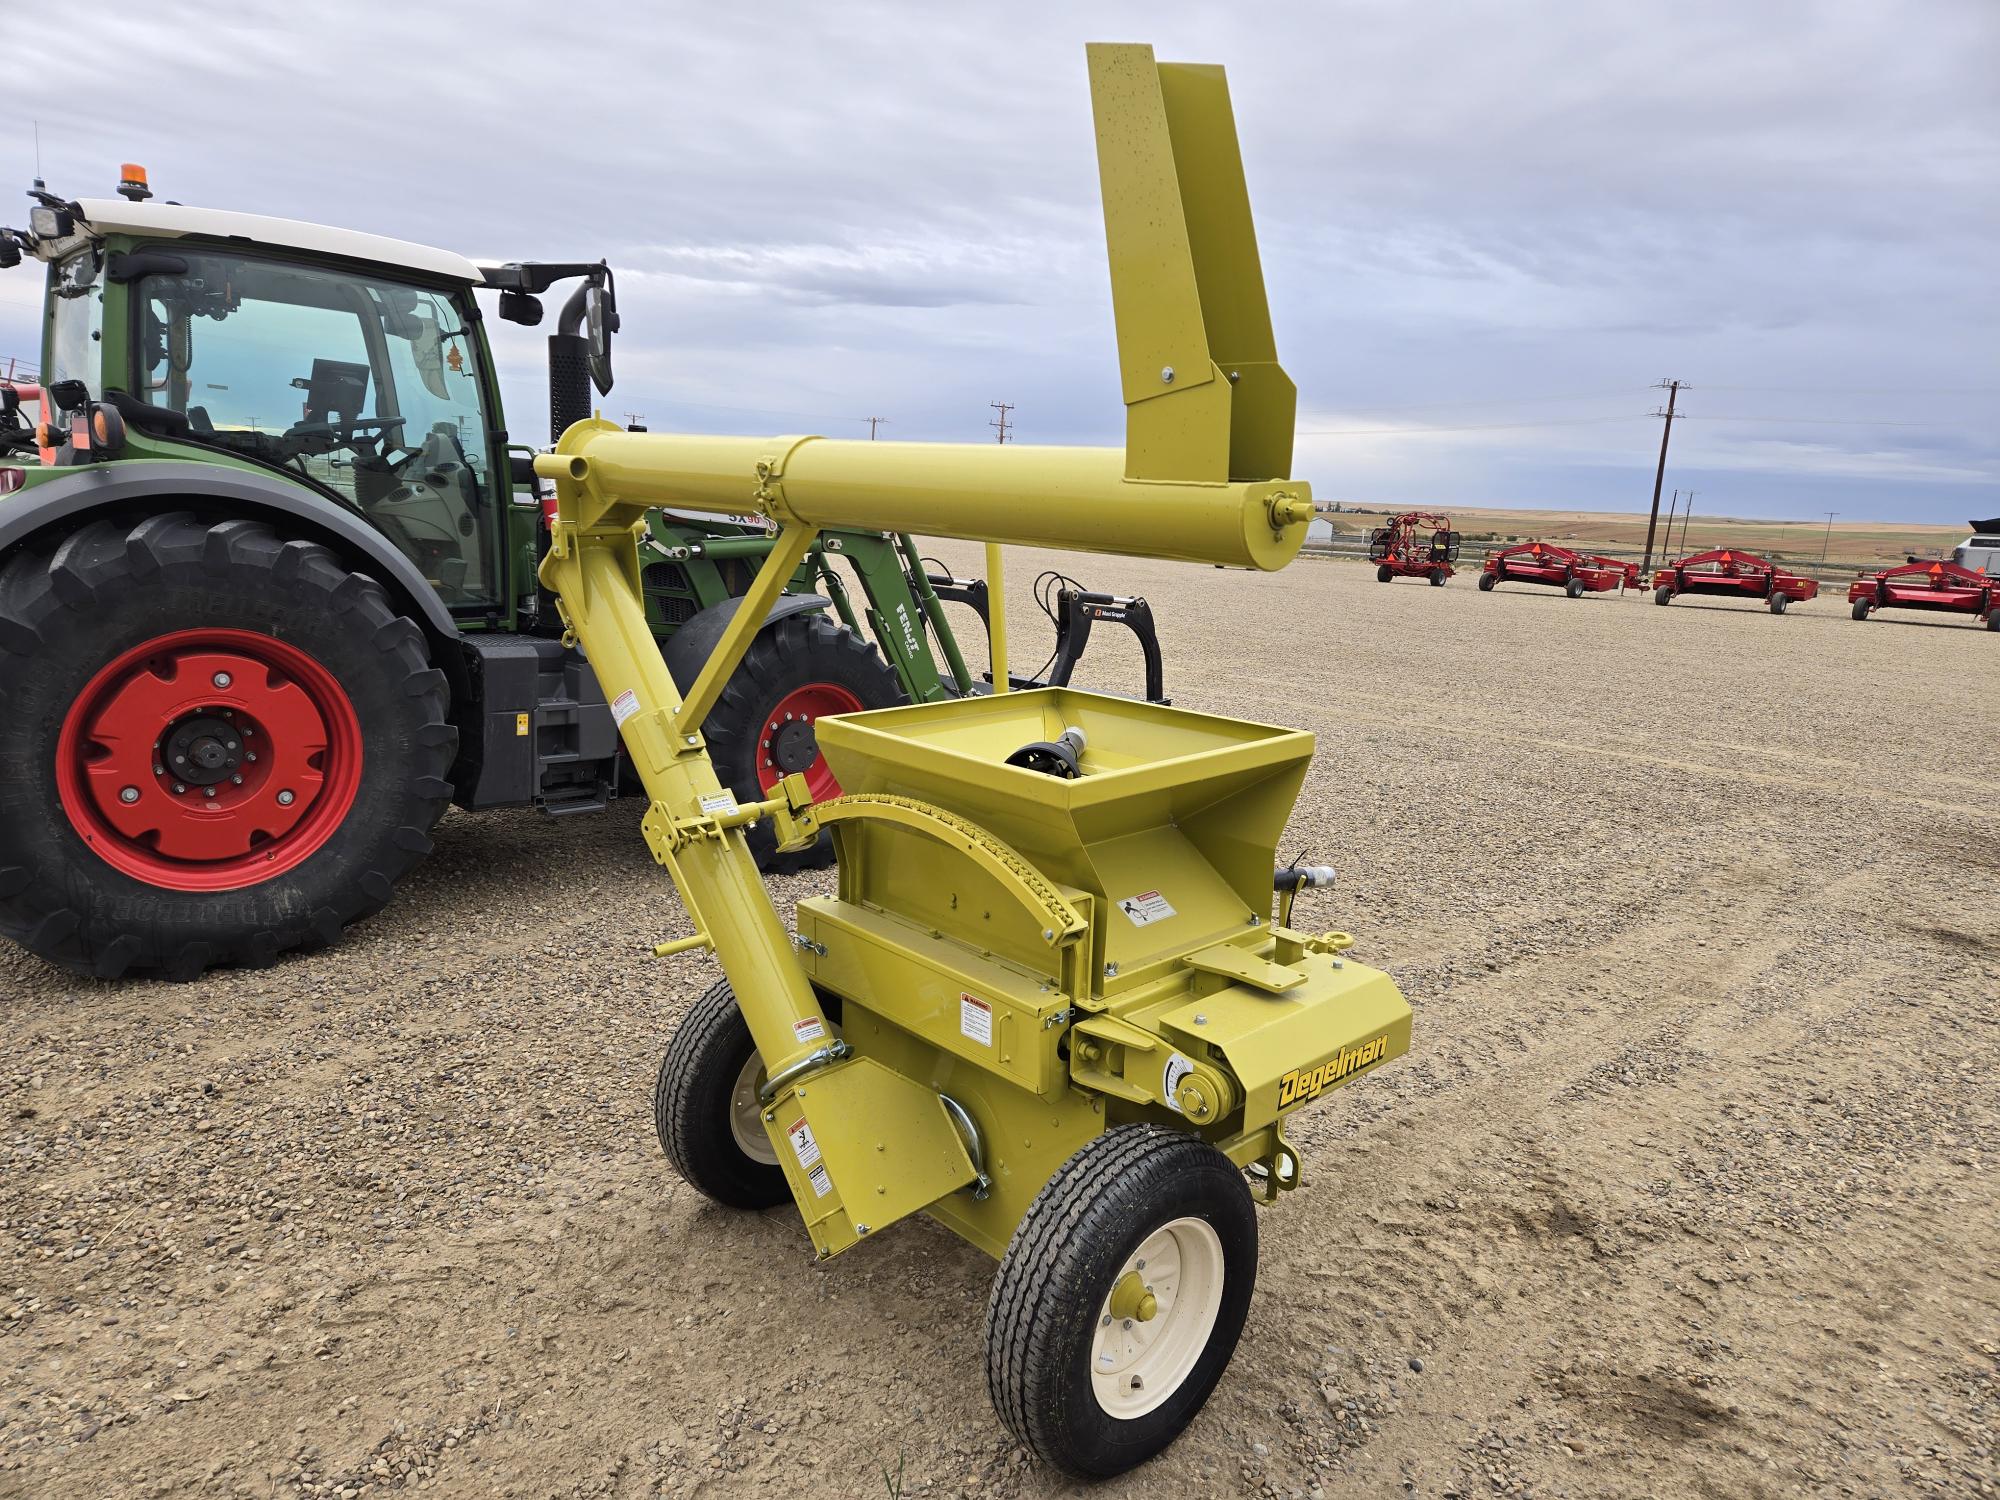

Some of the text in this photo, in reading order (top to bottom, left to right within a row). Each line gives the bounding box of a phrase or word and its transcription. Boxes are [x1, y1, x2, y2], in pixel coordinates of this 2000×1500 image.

[896, 603, 919, 651] FENDT
[904, 640, 914, 659] CARGO
[1278, 1033, 1389, 1111] Degelman
